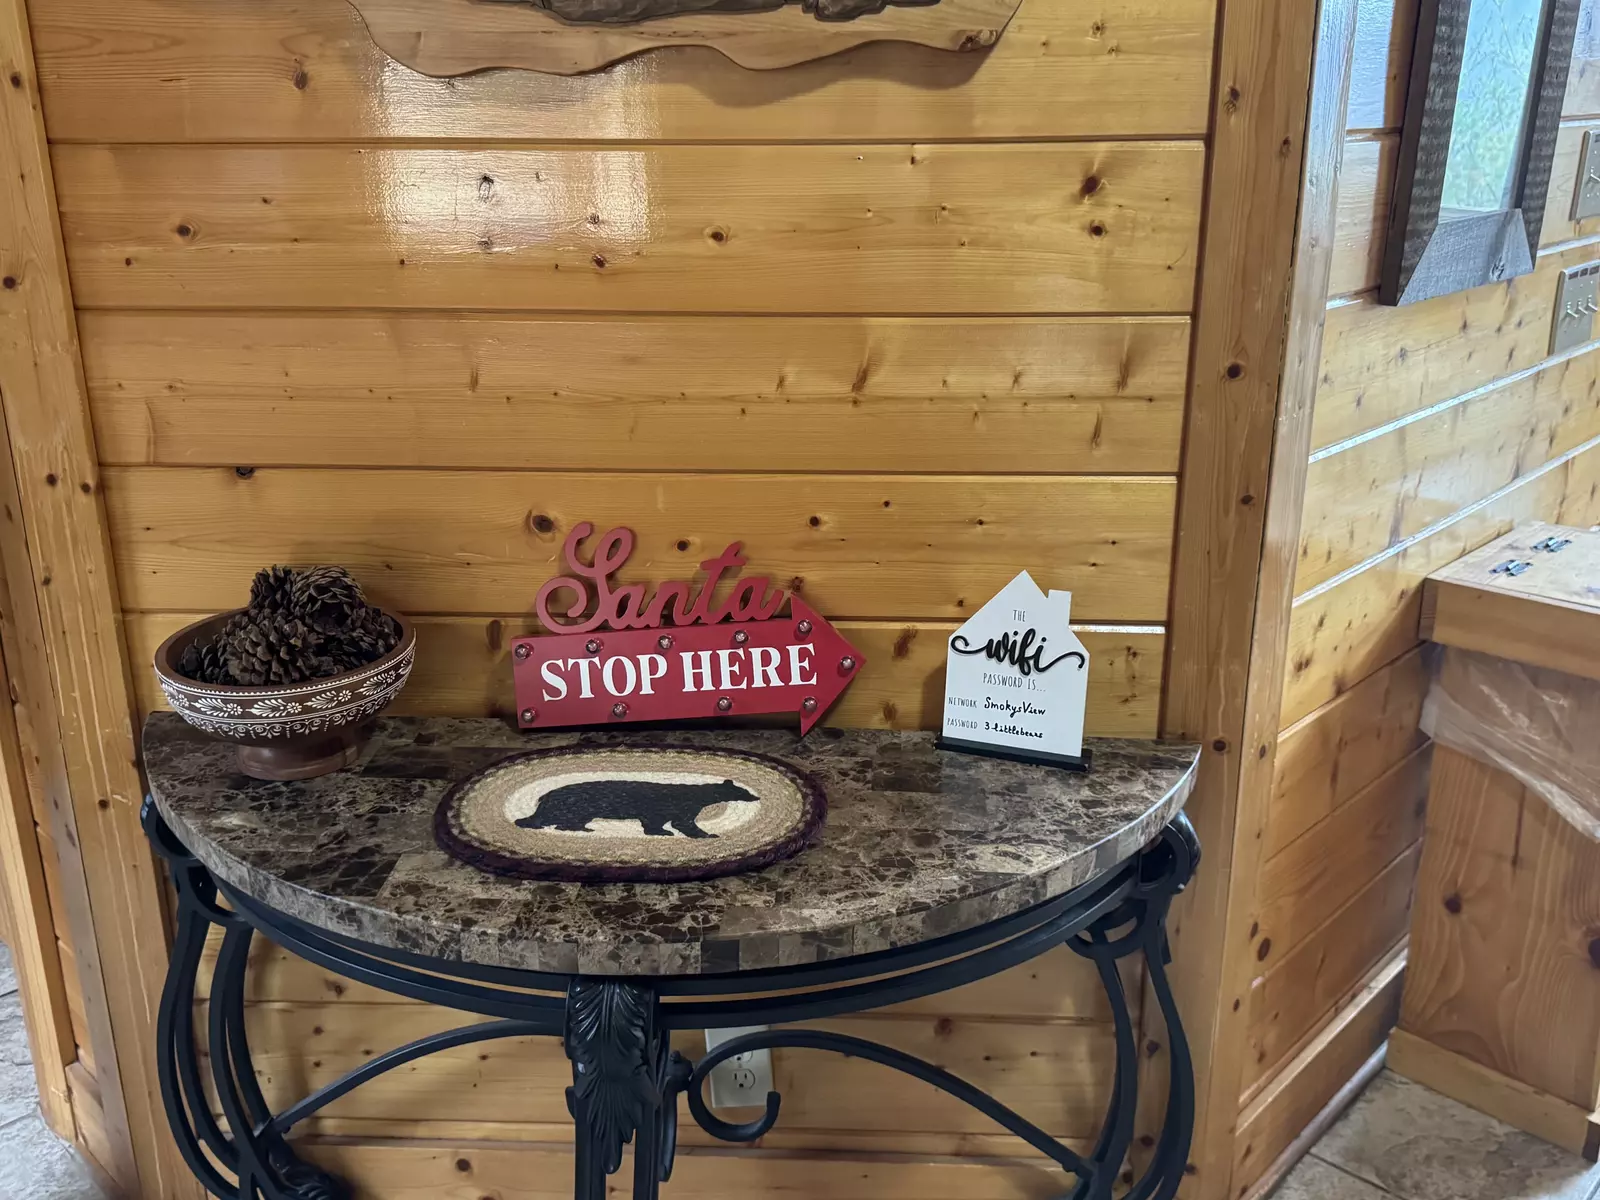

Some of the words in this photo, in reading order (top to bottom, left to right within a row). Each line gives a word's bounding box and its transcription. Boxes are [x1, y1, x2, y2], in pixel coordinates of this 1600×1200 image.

[535, 521, 786, 634] Santa
[1013, 609, 1026, 622] THE
[950, 628, 1086, 676] wifi
[540, 653, 668, 702] STOP
[680, 643, 818, 693] HERE
[983, 672, 1023, 688] PASSWORD
[1027, 678, 1046, 692] IS...
[948, 696, 977, 708] NETWORK
[984, 696, 1046, 718] SmokysView
[947, 717, 978, 729] PASSWORD
